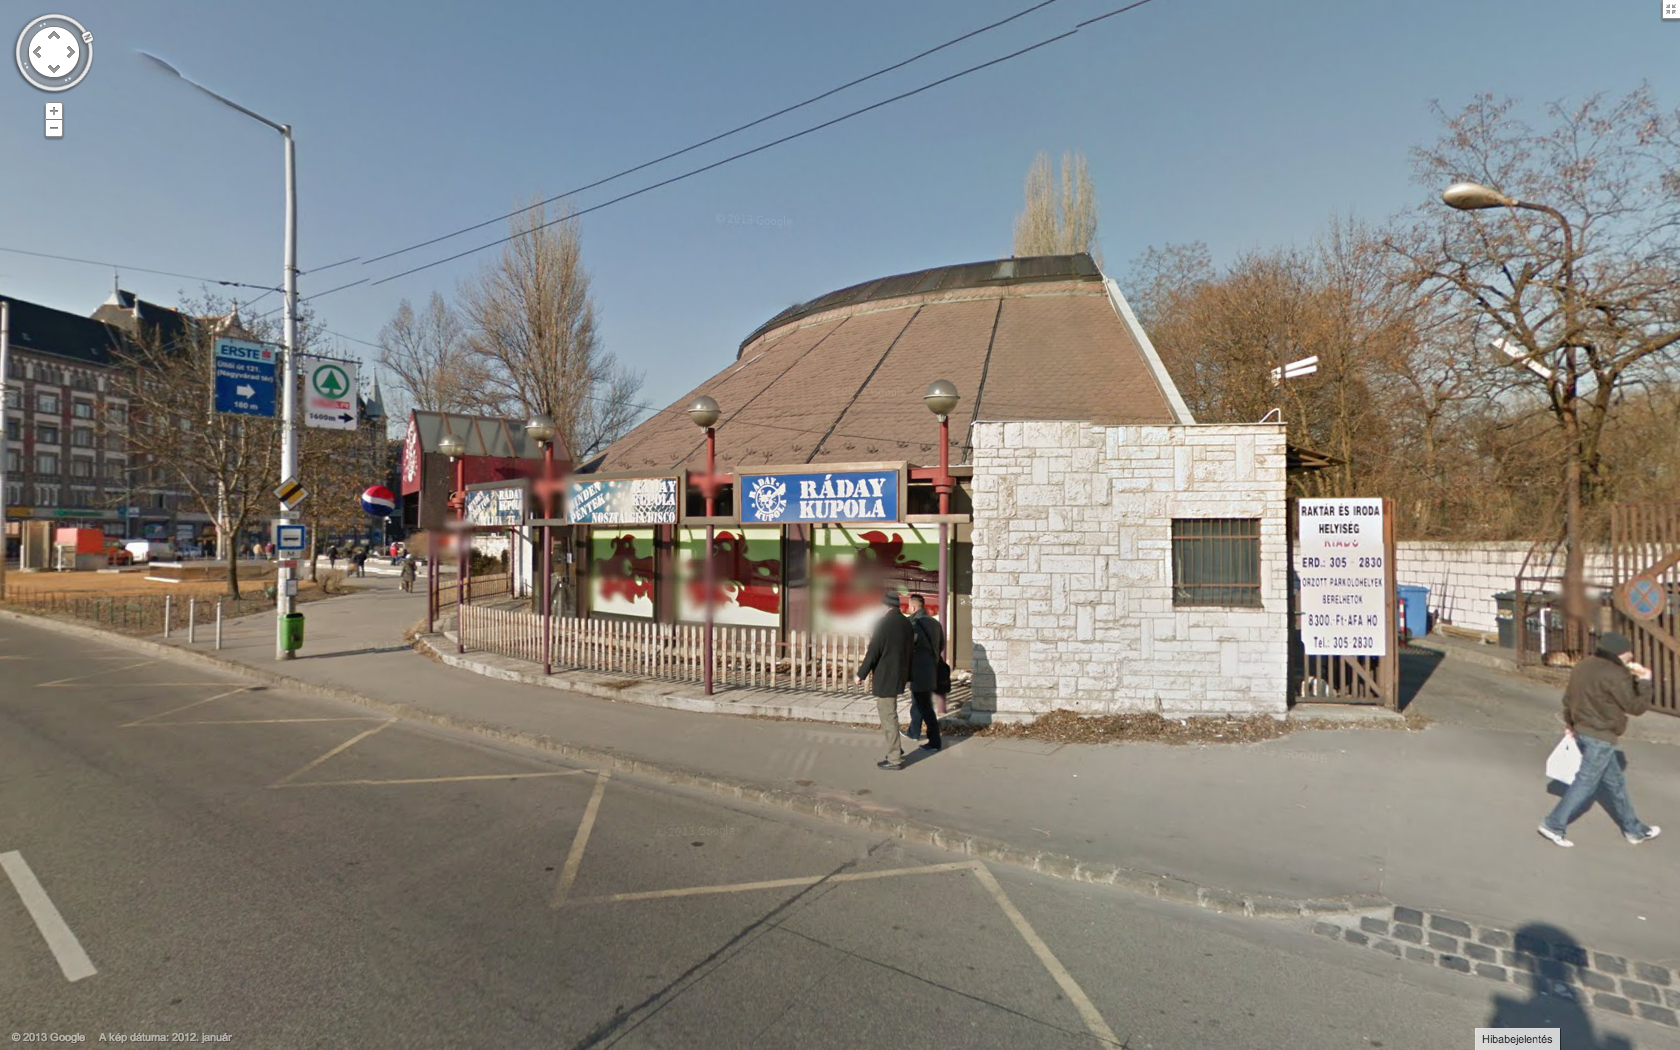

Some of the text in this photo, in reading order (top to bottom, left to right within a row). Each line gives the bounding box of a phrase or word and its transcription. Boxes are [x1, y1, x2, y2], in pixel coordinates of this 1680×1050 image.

[220, 344, 260, 360] ERSTE
[309, 412, 336, 421] 1600m
[799, 474, 886, 498] RÁDAY
[754, 499, 787, 521] KUPOLA
[799, 499, 886, 519] KUPOLA
[1301, 503, 1380, 516] RAKTÁR ÉS IRODA
[1318, 521, 1360, 534] HELYISÉG
[1329, 557, 1347, 568] 305
[1359, 557, 1382, 568] 2830
